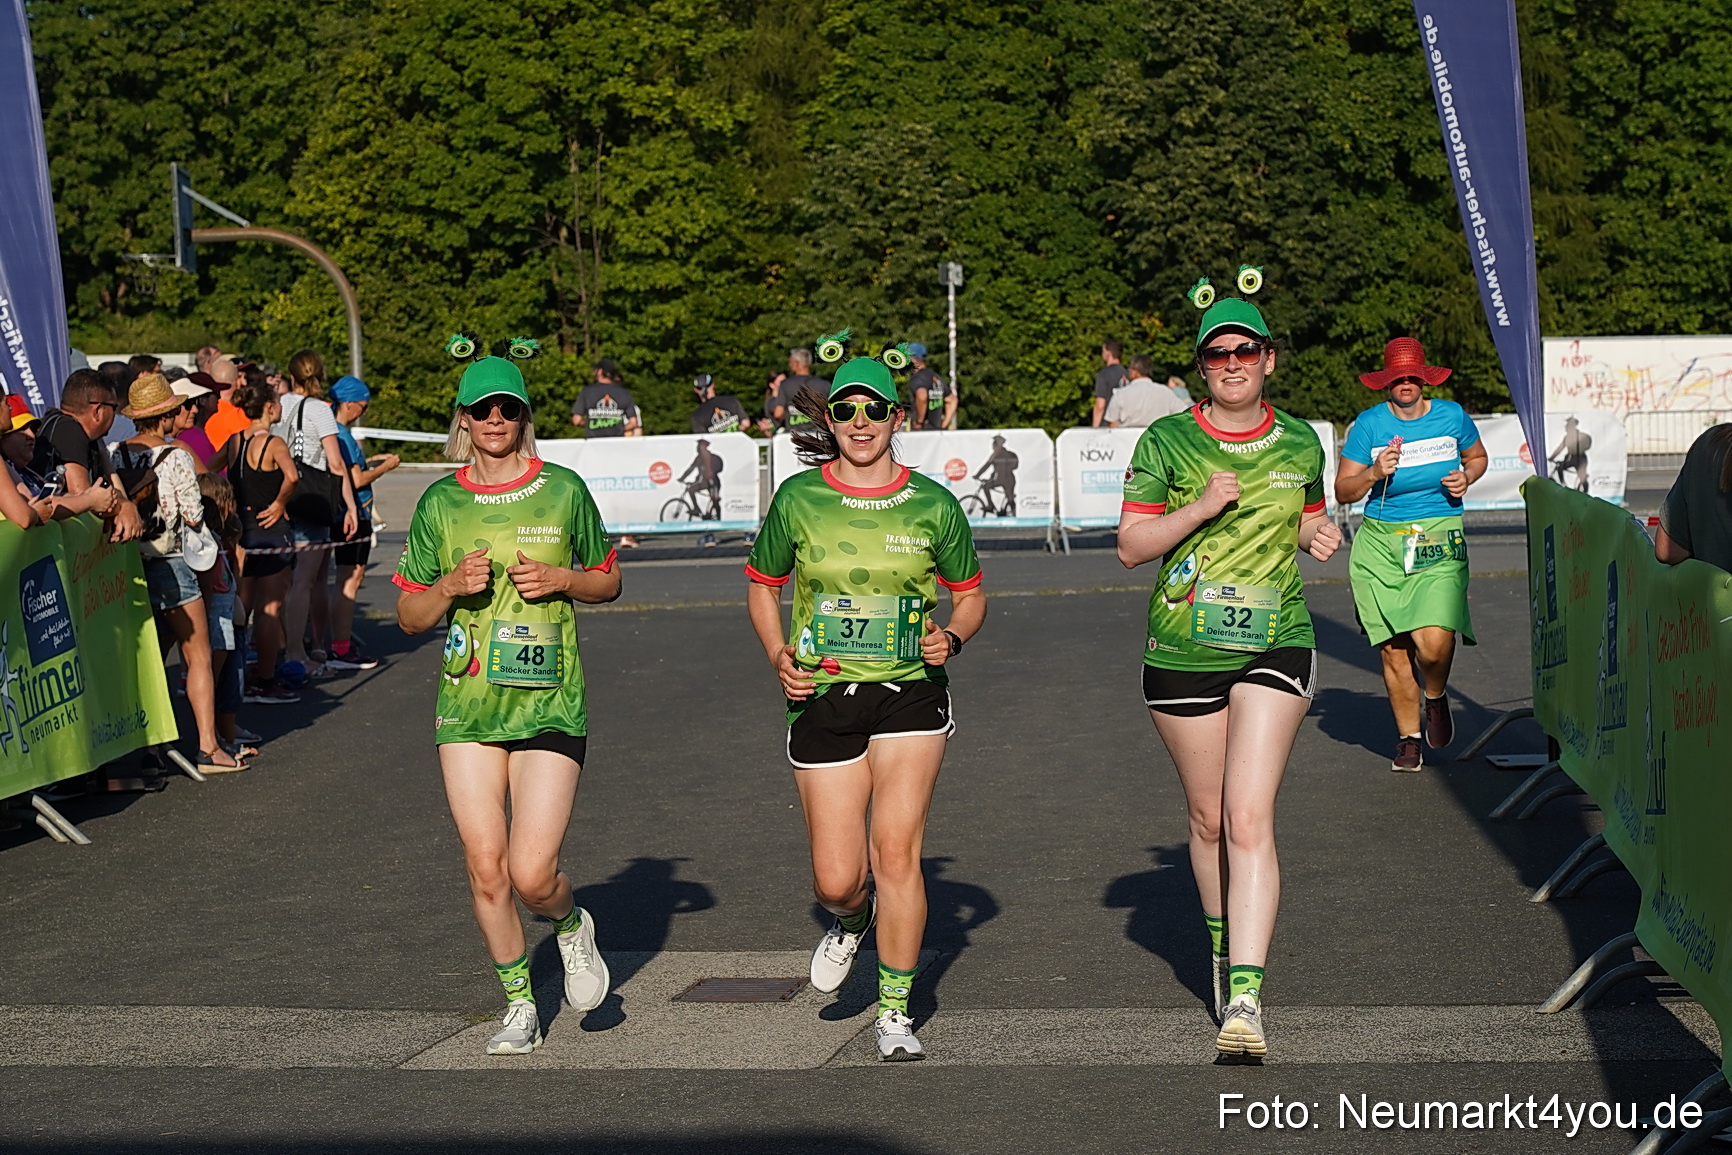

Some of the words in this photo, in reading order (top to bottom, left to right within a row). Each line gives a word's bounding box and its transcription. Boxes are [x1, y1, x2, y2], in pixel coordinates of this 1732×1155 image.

[1080, 449, 1114, 462] NOW
[516, 536, 561, 544] POWER-TEAM
[517, 526, 563, 535] TRENDHAUS
[885, 534, 930, 547] TRENDHAUS
[1414, 544, 1444, 560] 1439
[27, 589, 57, 615] Fischer
[33, 605, 59, 623] AUTOMOBILE
[1196, 610, 1206, 633] RUN
[1222, 606, 1252, 629] 32
[840, 618, 870, 639] 37
[886, 621, 895, 652] 2022
[1241, 630, 1265, 640] Sarah
[1267, 613, 1277, 644] 2022
[827, 639, 849, 648] Meier
[850, 640, 883, 650] Theresa
[491, 649, 501, 671] RUN
[515, 645, 545, 666] 48
[500, 665, 530, 675] Stöcker
[532, 667, 557, 676] Sandra
[30, 703, 79, 744] neumarkt
